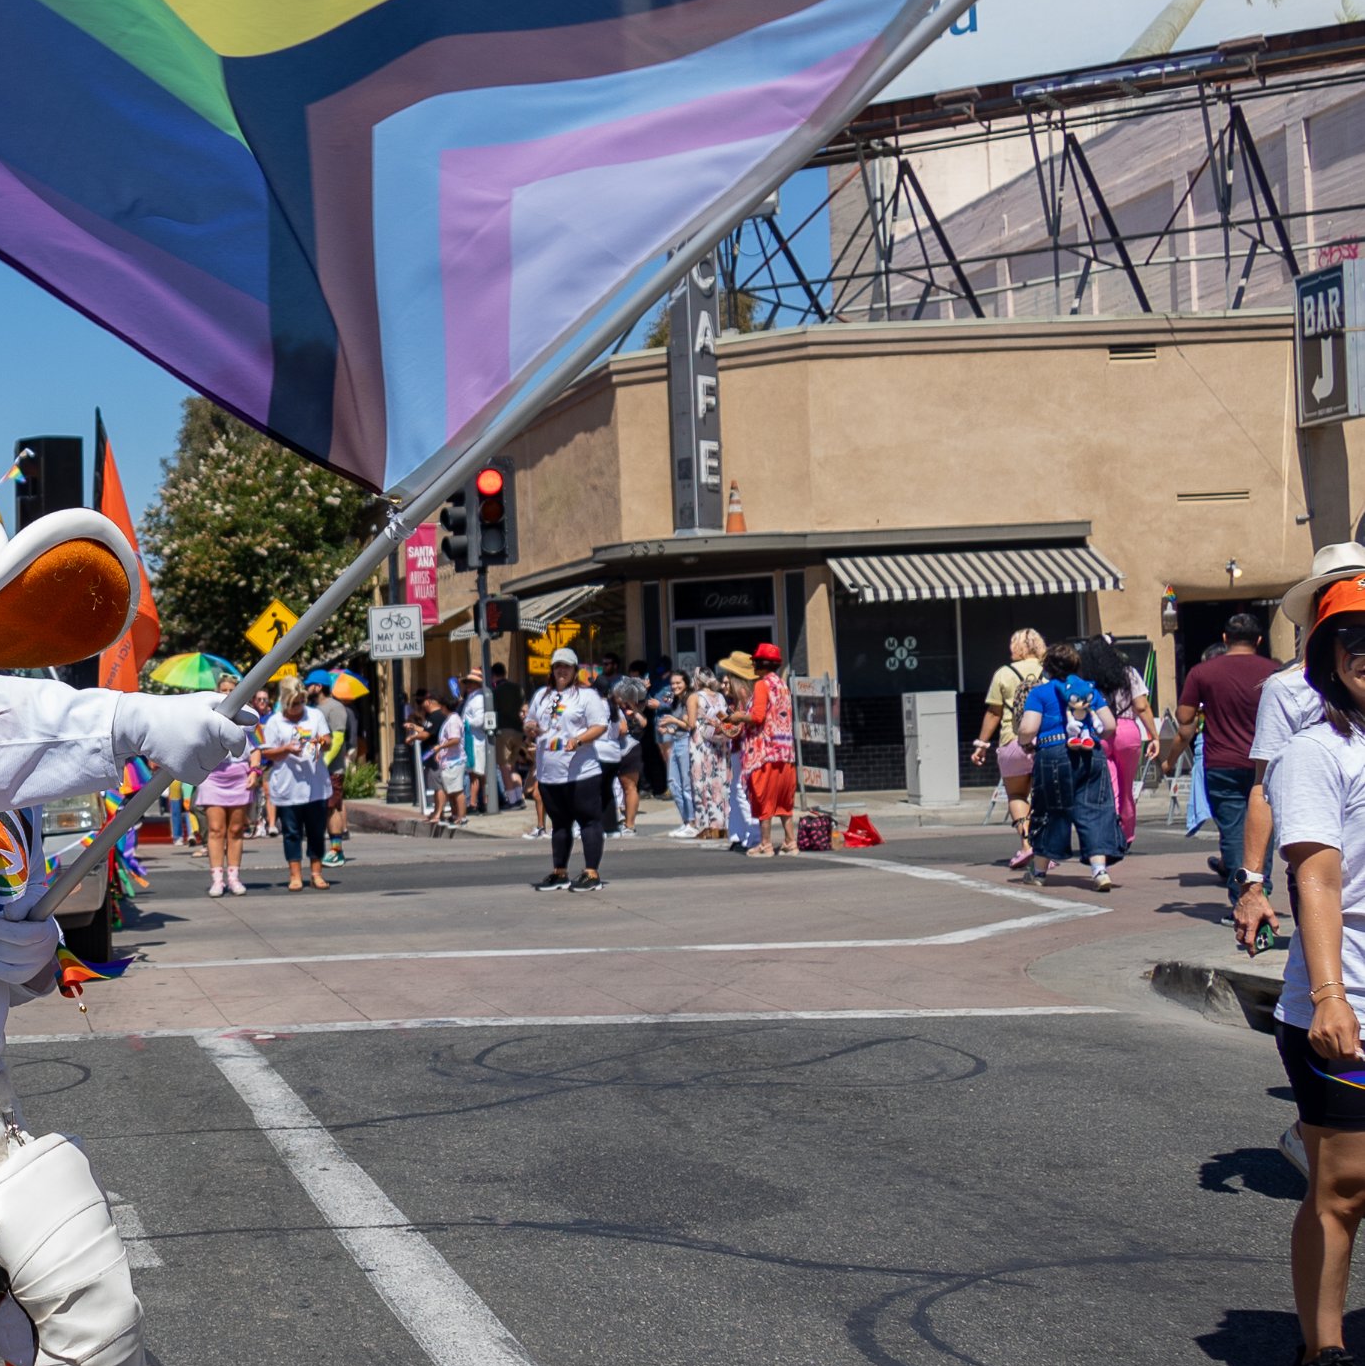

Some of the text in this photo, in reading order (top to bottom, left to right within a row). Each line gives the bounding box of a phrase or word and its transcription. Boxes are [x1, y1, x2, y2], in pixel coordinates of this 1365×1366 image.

[1302, 286, 1341, 337] BAR
[690, 249, 720, 485] CAFE
[408, 546, 434, 557] SANTA
[418, 557, 434, 567] ANA
[415, 585, 436, 598] VILLAGE
[705, 592, 751, 612] Open
[377, 631, 416, 642] MAY USE
[374, 642, 420, 653] FULL LANE
